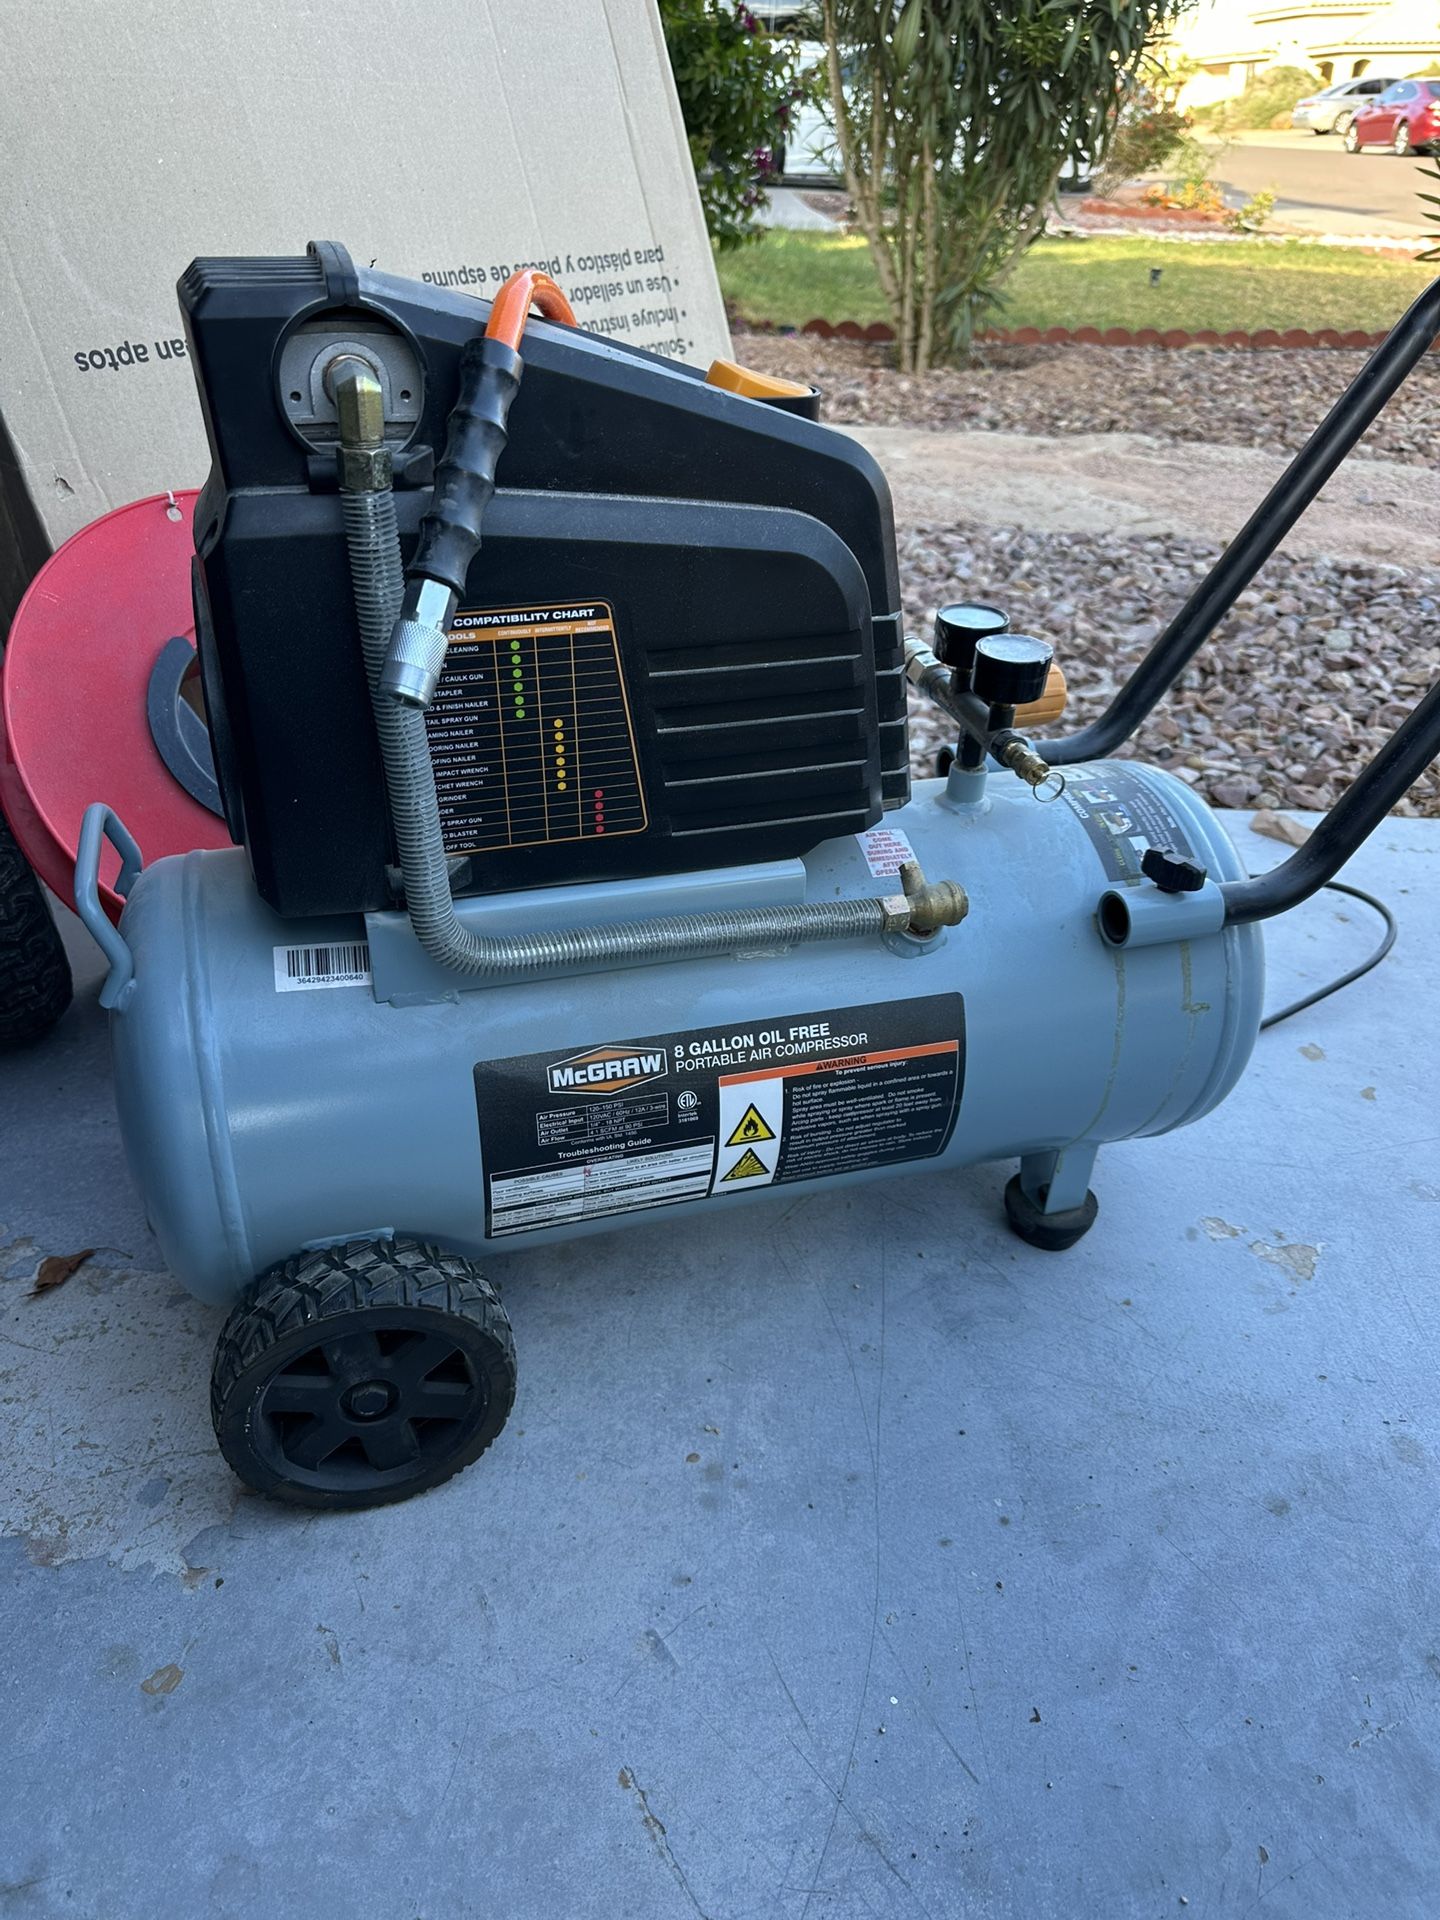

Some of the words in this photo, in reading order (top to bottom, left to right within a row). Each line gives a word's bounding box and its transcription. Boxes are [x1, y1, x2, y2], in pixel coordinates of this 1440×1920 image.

[634, 245, 664, 264] para
[566, 254, 575, 273] y
[578, 254, 631, 274] plástico
[491, 264, 511, 282] de
[627, 279, 644, 295] un
[646, 275, 672, 293] Use
[569, 282, 625, 302] sellador
[632, 307, 679, 328] Incluye
[74, 340, 150, 371] aptos
[453, 611, 550, 627] COMPATIBILITY
[552, 608, 595, 620] CHART
[447, 632, 477, 641] OOLS
[445, 675, 468, 683] CAULK
[469, 673, 484, 681] GUN
[442, 703, 463, 711] FINISH
[441, 716, 463, 724] SPRAY
[450, 728, 474, 737] NAILER
[455, 741, 479, 749] NAILER
[453, 755, 477, 763] NAILER
[436, 769, 459, 777] IMPACT
[461, 766, 488, 775] WRENCH
[455, 780, 484, 788] WRENCH
[439, 794, 467, 803] GRINDER
[447, 818, 468, 827] SPRAY
[450, 829, 479, 838] BLASTER
[875, 868, 901, 876] OPERA
[674, 1045, 685, 1059] 8
[689, 1035, 755, 1056] GALLON
[758, 1030, 785, 1046] OIL
[789, 1022, 830, 1041] FREE
[675, 1053, 748, 1074] PORTABLE
[750, 1048, 773, 1062] AIR
[775, 1033, 868, 1057] COMPRESSOR
[821, 1056, 867, 1070] WARNING
[844, 1066, 866, 1075] prevent
[867, 1063, 888, 1072] serious
[552, 1054, 662, 1088] McGRAW
[548, 1109, 576, 1119] Pressure
[540, 1119, 567, 1128] Electrical
[568, 1116, 584, 1124] Input
[558, 1141, 626, 1159] Troubleshooting
[628, 1137, 651, 1147] Guide
